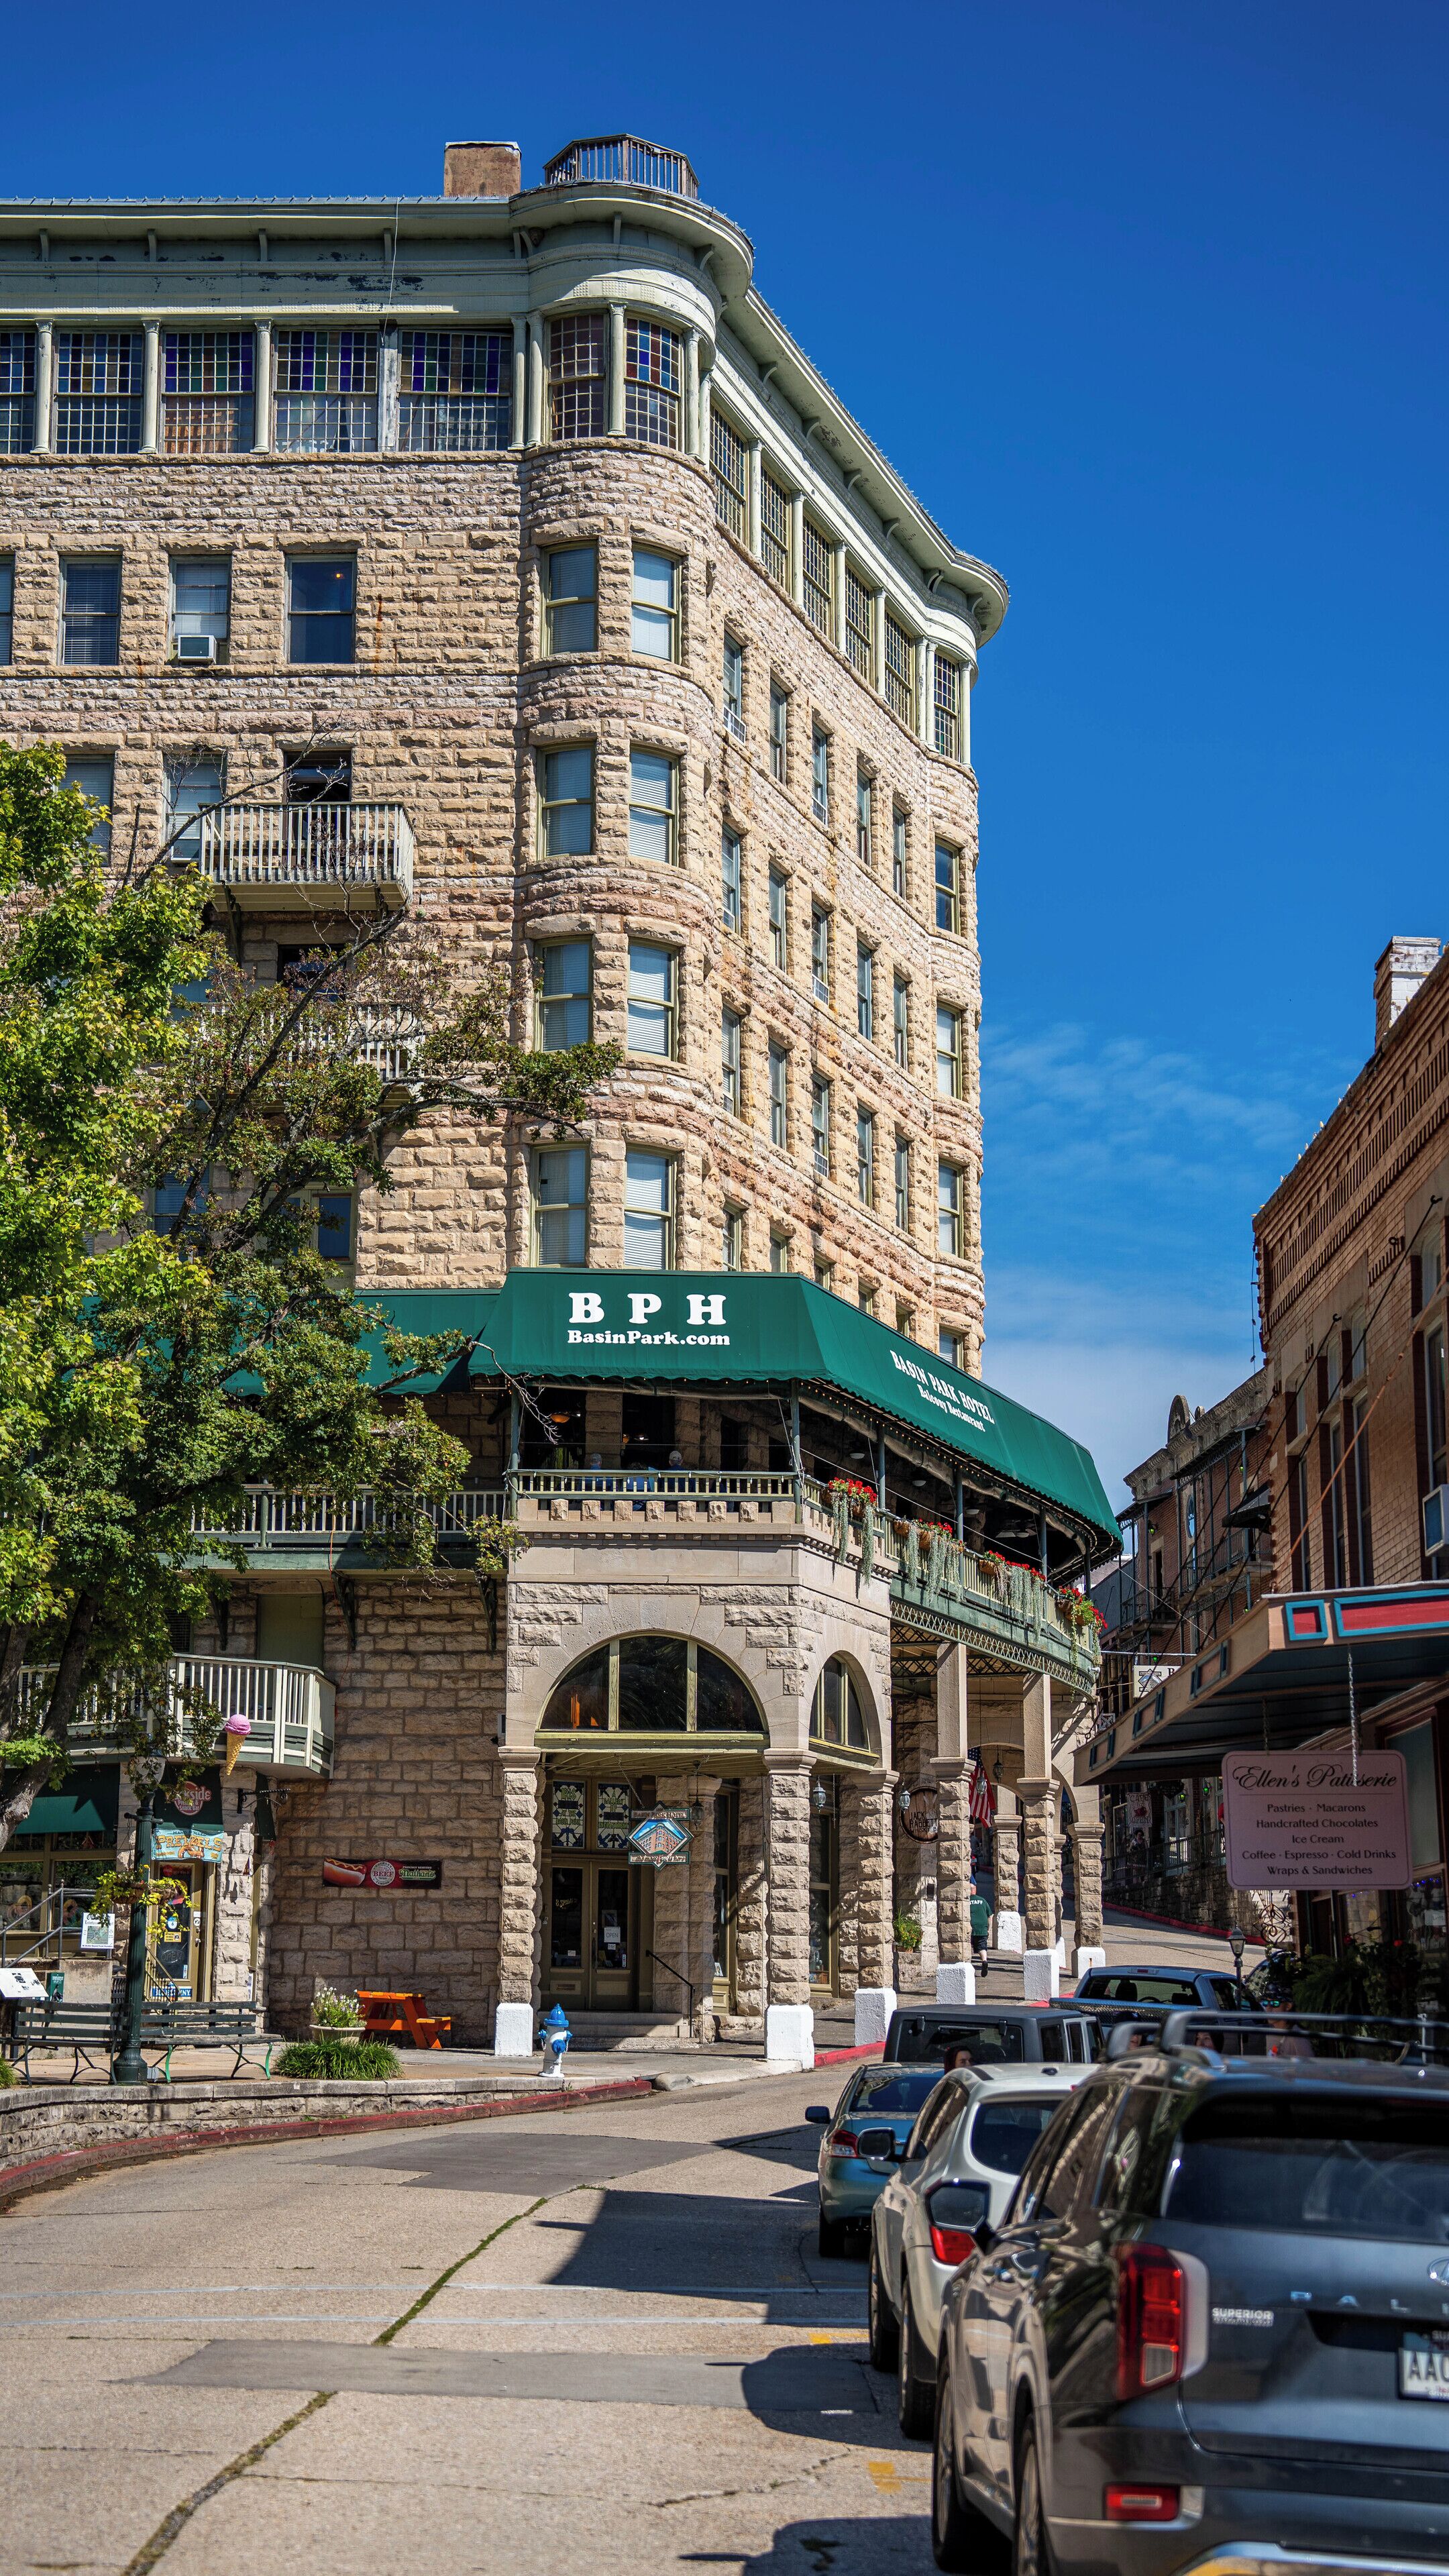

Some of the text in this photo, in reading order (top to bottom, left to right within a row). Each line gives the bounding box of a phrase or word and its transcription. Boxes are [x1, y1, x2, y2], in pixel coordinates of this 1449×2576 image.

[568, 1292, 727, 1325] B P H
[567, 1330, 731, 1346] BasinPark.com
[890, 1350, 996, 1424] BASIN PARK HOTEL
[917, 1384, 986, 1432] Balcony Restaurant
[1167, 1668, 1175, 1676] B
[1232, 1764, 1397, 1790] Ellen's Patiserie
[1267, 1804, 1366, 1812] Pastries Macarons
[910, 1811, 926, 1820] JACK
[910, 1819, 938, 1828] RABBETT
[1256, 1819, 1378, 1828] Handcrafted Chocolates
[156, 1835, 222, 1852] PRETZELS
[1292, 1835, 1344, 1843] Ice Cream
[1242, 1849, 1396, 1861] Coffee Espresso Cold Drinks
[398, 1869, 437, 1880] Nathan's
[1267, 1866, 1299, 1876] Wraps
[1313, 1866, 1373, 1875] Sandwiches
[1212, 2308, 1273, 2319] SUPERIOR
